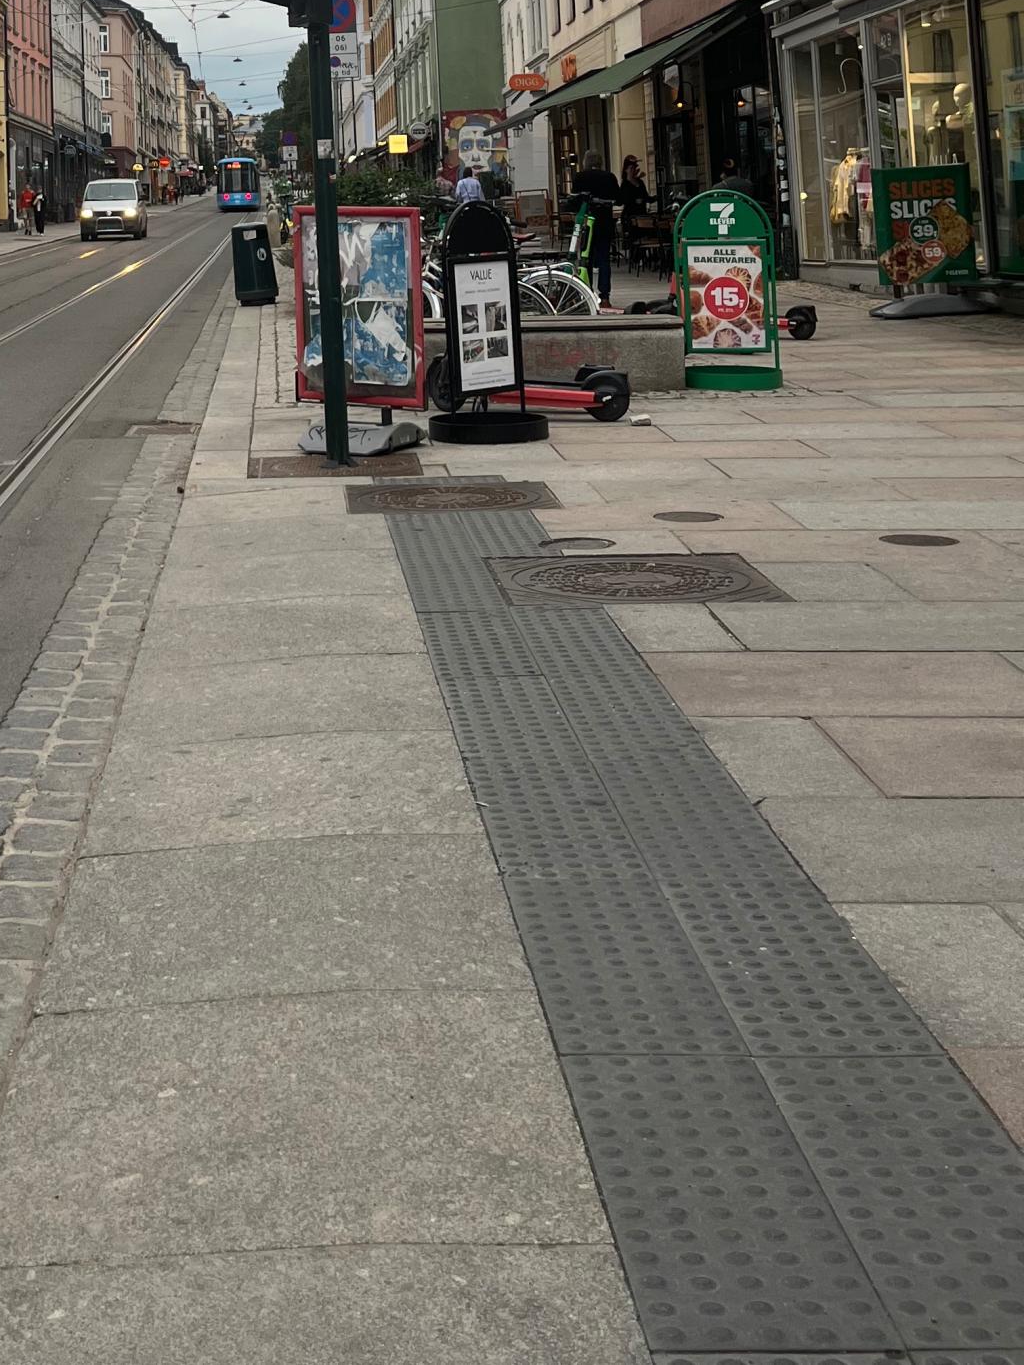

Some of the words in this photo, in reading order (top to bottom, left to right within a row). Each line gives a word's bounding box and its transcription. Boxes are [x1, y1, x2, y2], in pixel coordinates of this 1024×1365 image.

[515, 78, 539, 87] DIGG
[889, 179, 956, 198] SLICES
[890, 197, 957, 219] SLICS
[713, 248, 737, 256] ALLE
[693, 256, 757, 264] BAKERVARER
[469, 268, 493, 281] VALUE
